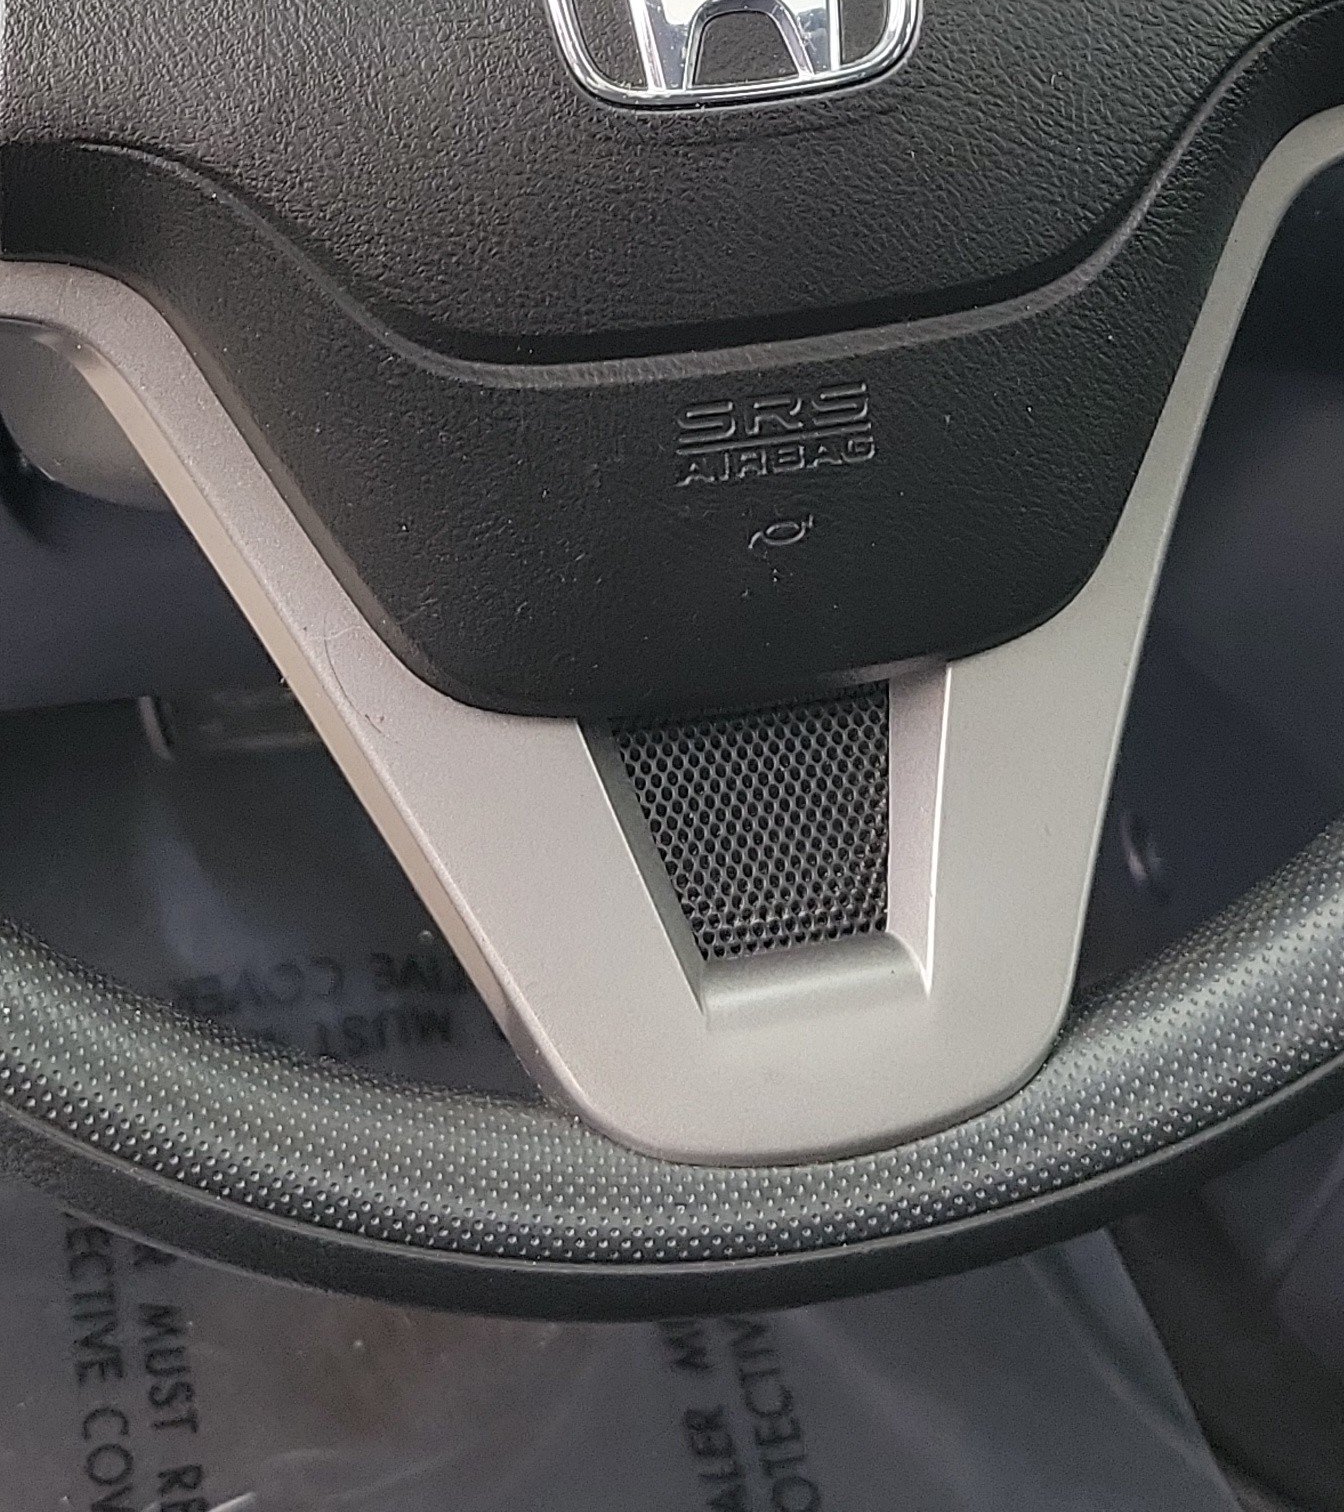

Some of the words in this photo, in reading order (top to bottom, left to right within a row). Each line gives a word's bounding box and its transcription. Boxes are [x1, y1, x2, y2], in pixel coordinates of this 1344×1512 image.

[676, 382, 869, 444] SRS
[674, 436, 876, 488] AIRBAG
[139, 1303, 200, 1435] MUST
